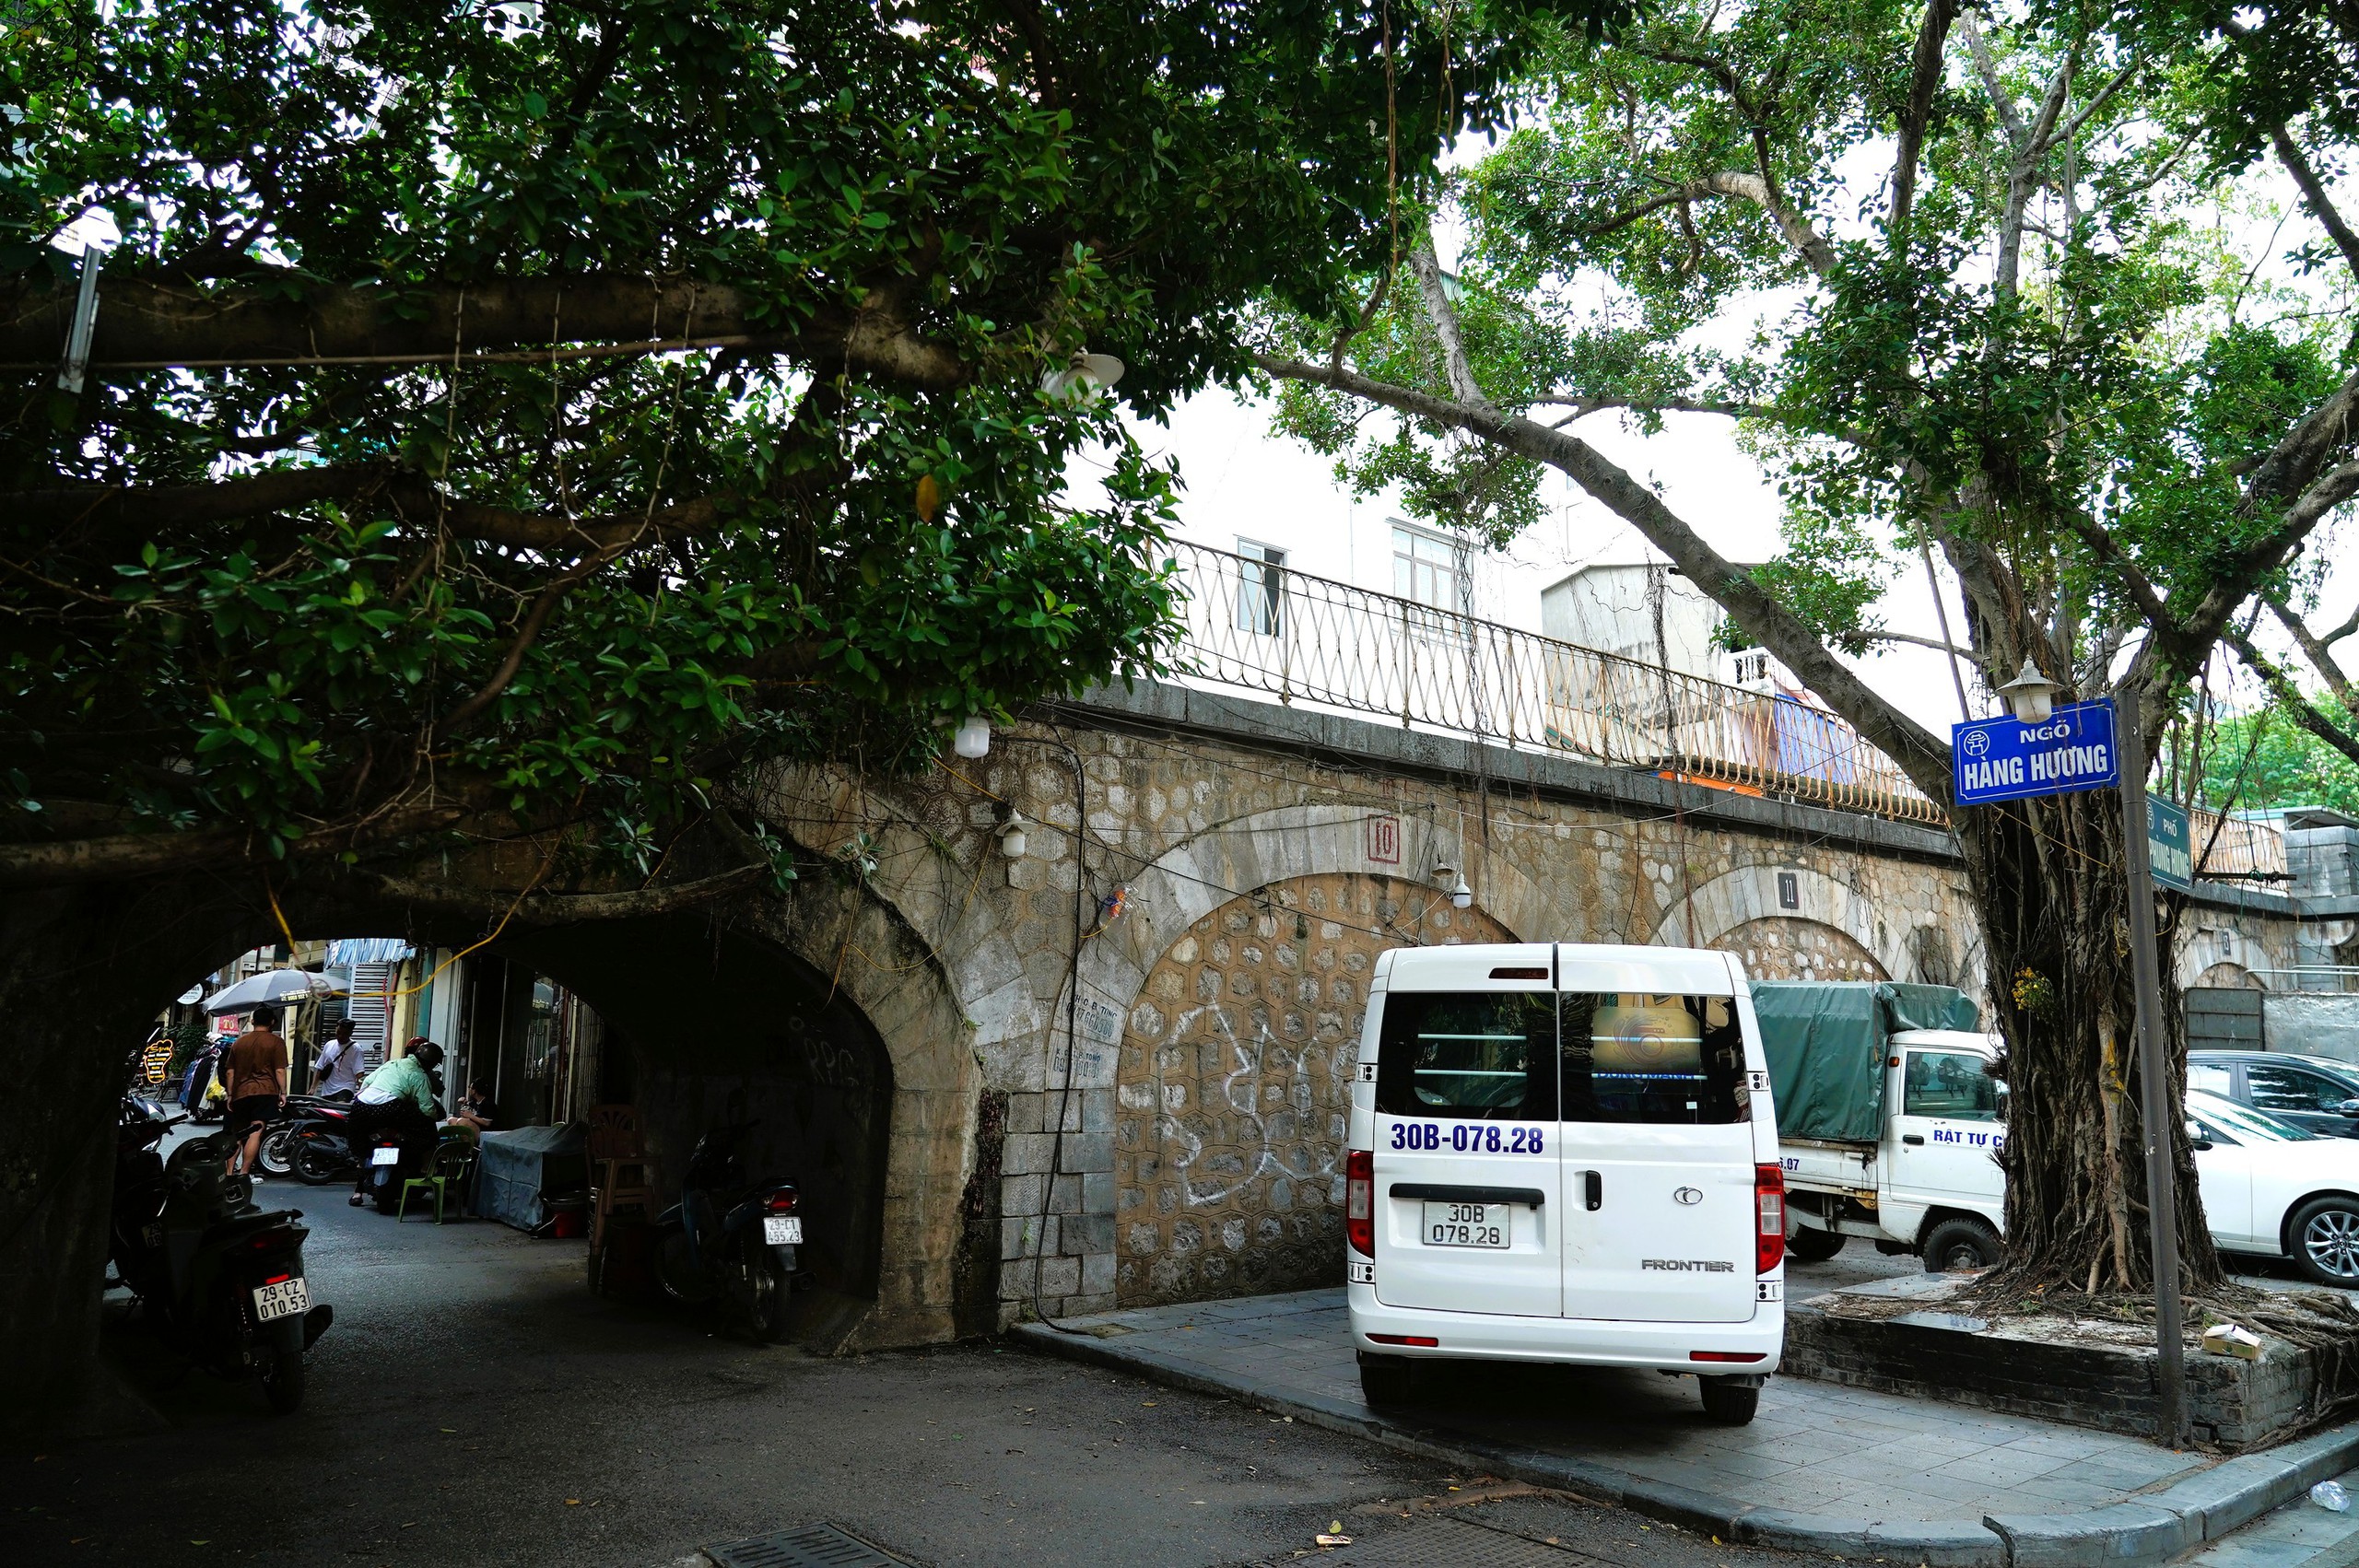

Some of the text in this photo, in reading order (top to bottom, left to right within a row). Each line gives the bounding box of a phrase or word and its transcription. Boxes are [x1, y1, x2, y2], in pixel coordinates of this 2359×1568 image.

[2020, 720, 2071, 743] NGÕ
[1964, 743, 2108, 790] HÀNG HƯƠNG
[1376, 820, 1392, 856] 10
[2163, 818, 2177, 837] PHỐ
[2148, 835, 2189, 880] PHÙNG HƯNG
[1785, 879, 1794, 903] 11
[1391, 1123, 1543, 1154] 30B-078.28
[1967, 1132, 1989, 1148] TỰ
[769, 1219, 796, 1230] 29-C1
[1448, 1204, 1485, 1223] 30B
[1432, 1223, 1500, 1245] 078.28
[1641, 1258, 1734, 1272] FRONTIER
[261, 1280, 299, 1302] 29-C2
[260, 1294, 308, 1319] 010.53
